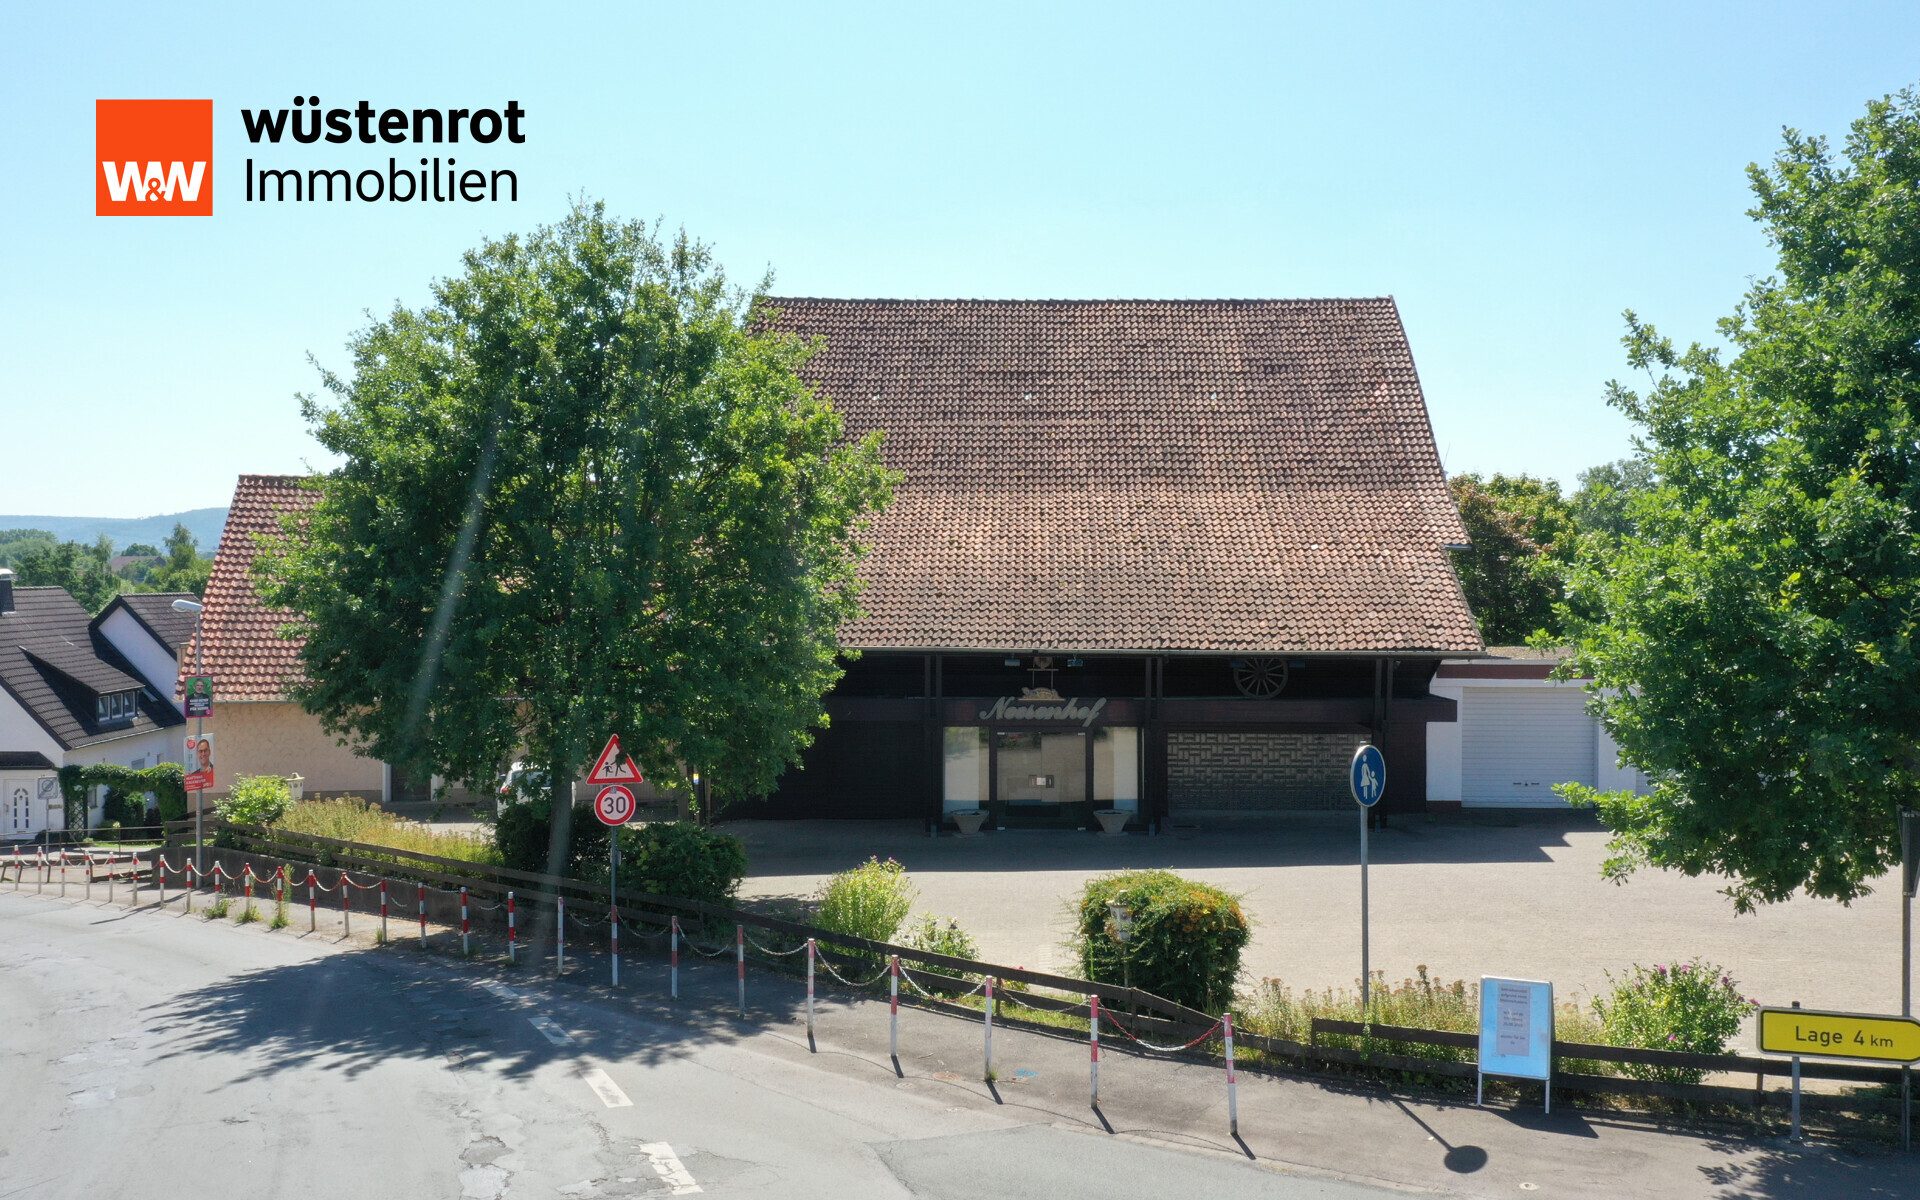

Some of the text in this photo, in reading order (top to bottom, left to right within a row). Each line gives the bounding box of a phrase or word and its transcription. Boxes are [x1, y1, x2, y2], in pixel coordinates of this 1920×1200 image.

[604, 796, 626, 814] 30
[1795, 1025, 1894, 1048] Lage 4 km
